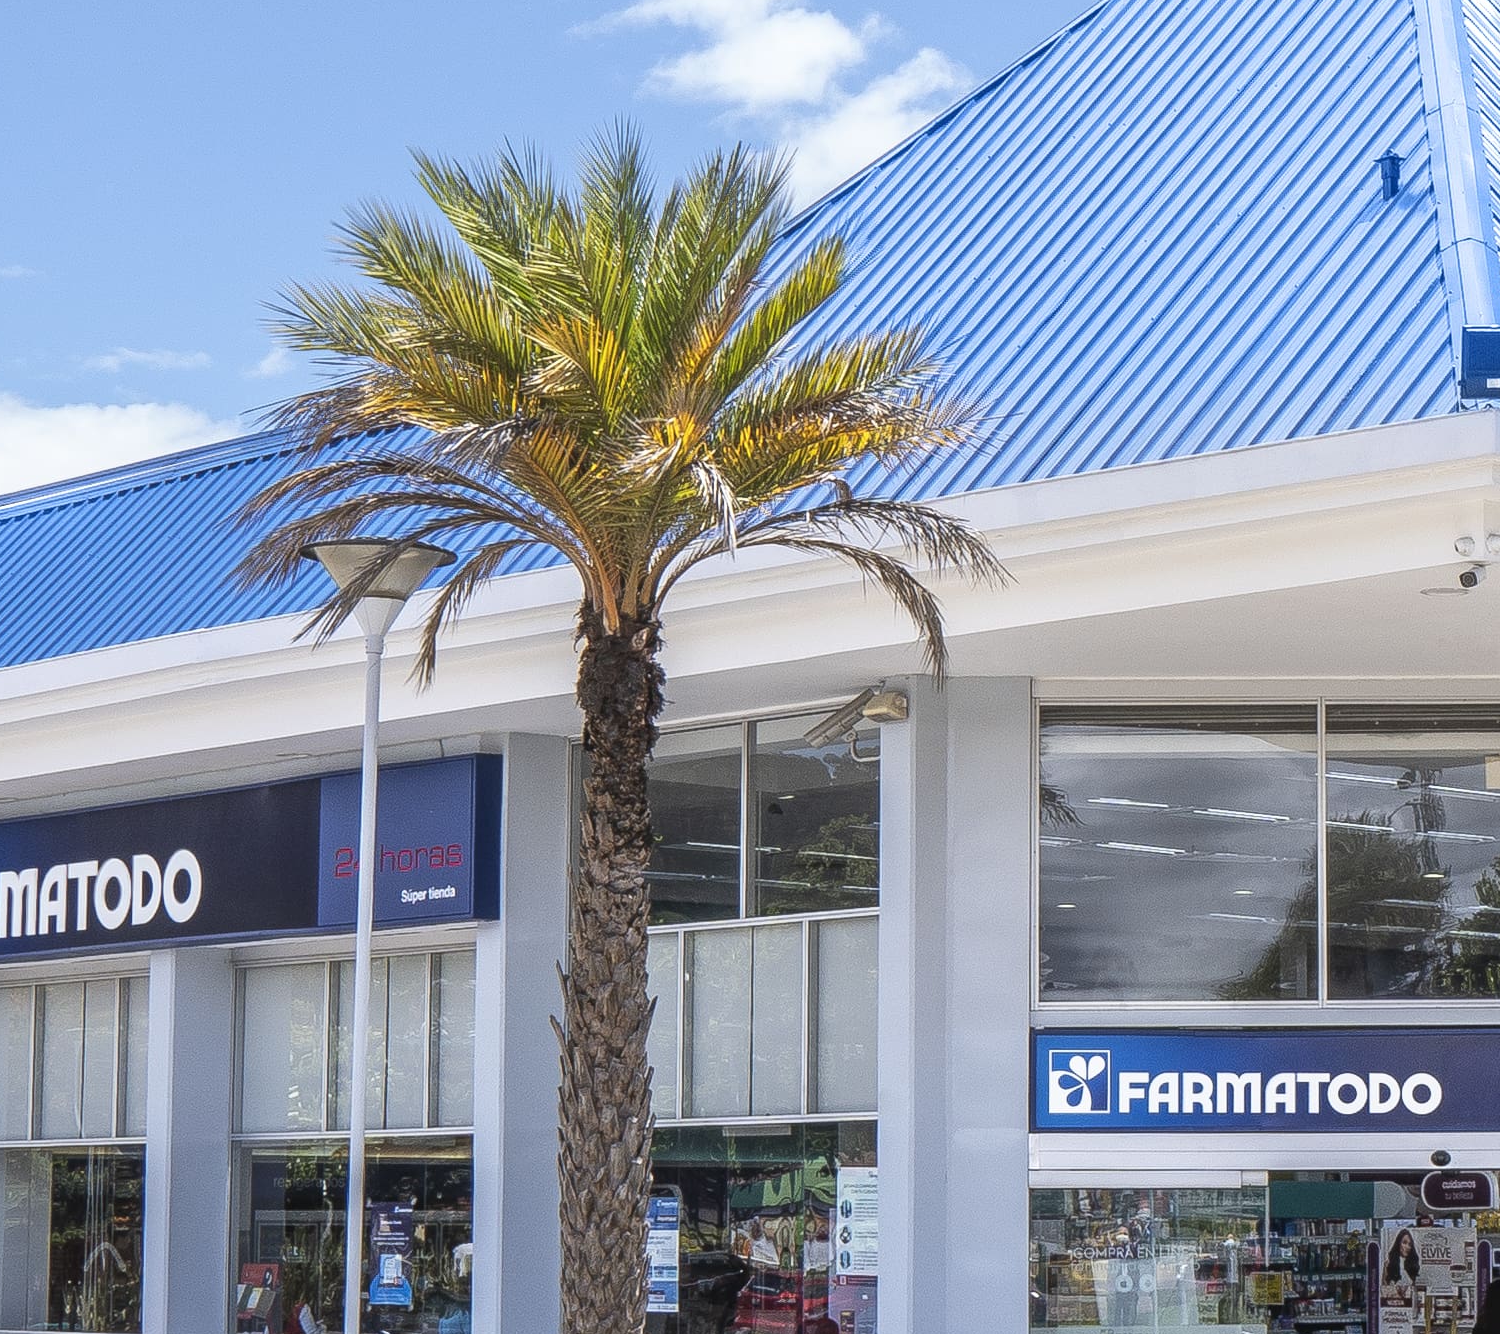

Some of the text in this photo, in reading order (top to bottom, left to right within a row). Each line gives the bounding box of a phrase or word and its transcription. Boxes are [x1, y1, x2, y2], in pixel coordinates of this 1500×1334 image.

[333, 843, 464, 879] 2 horas
[401, 885, 456, 904] Súper tienda
[1118, 1071, 1443, 1114] FARMATODO
[1421, 1247, 1451, 1258] ELVIVE
